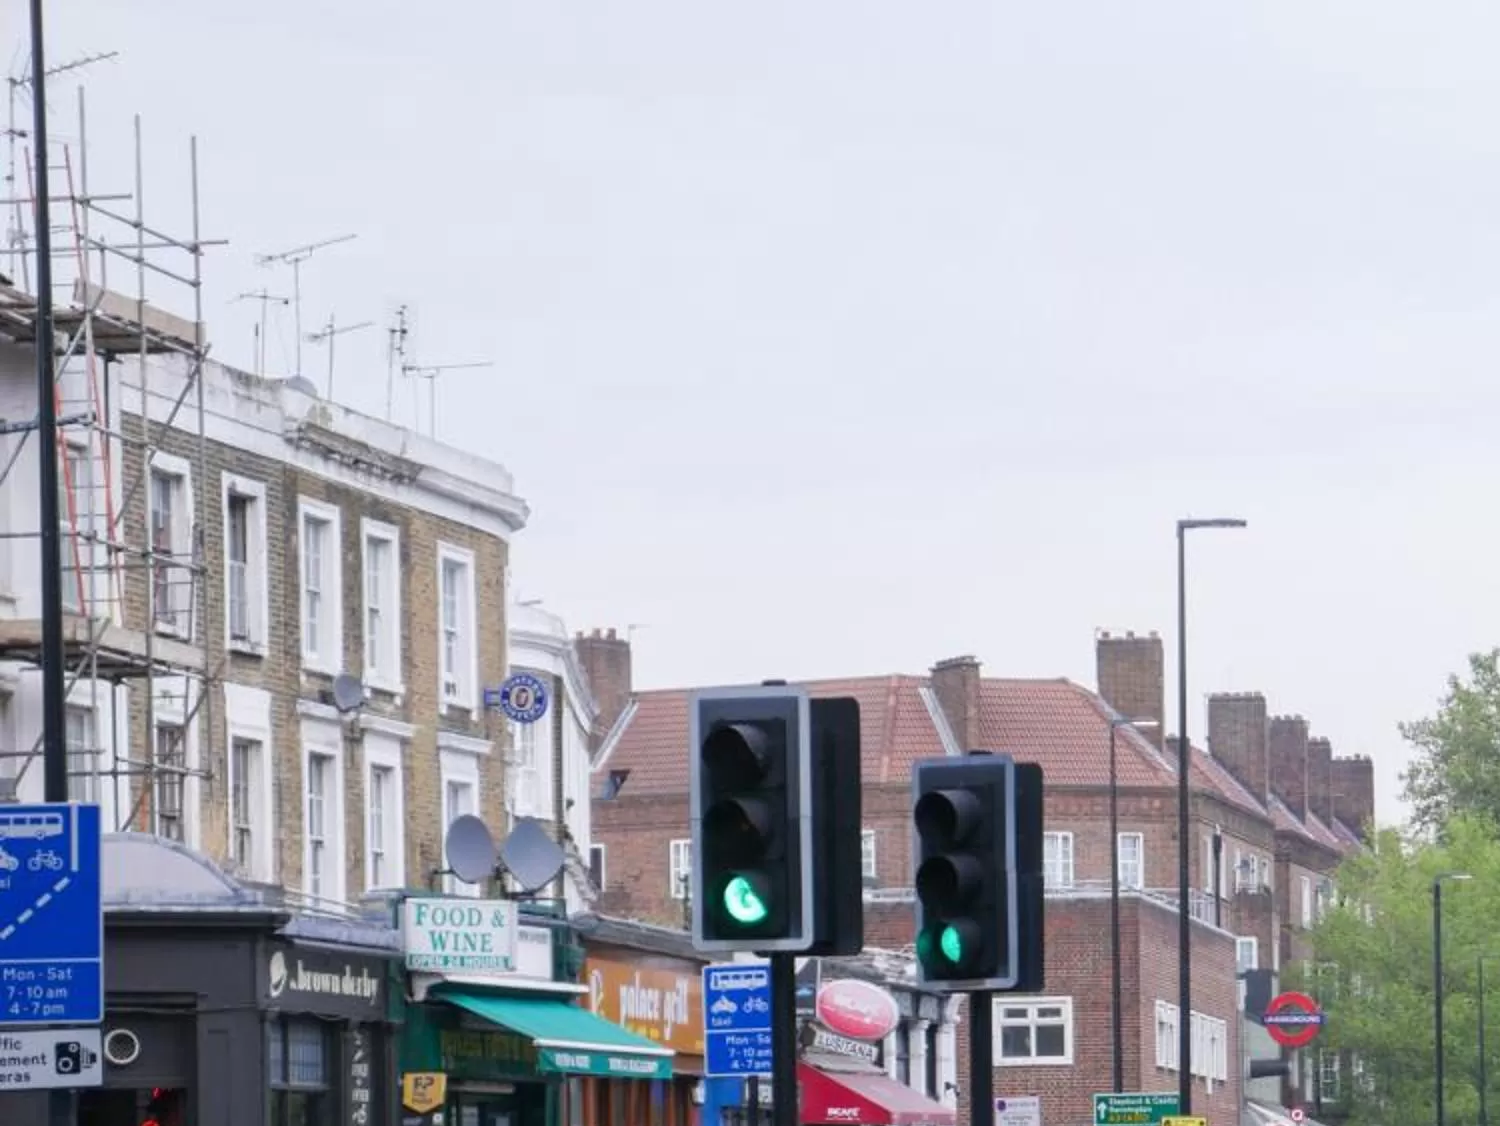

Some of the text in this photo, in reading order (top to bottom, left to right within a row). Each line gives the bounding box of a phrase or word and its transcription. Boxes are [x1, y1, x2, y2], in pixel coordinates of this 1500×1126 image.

[415, 903, 505, 928] FOOD &
[428, 930, 493, 953] WINE
[3, 967, 36, 980] Mon
[47, 967, 73, 980] Sat
[297, 959, 378, 1006] brown derby
[0, 1072, 31, 1083] eras
